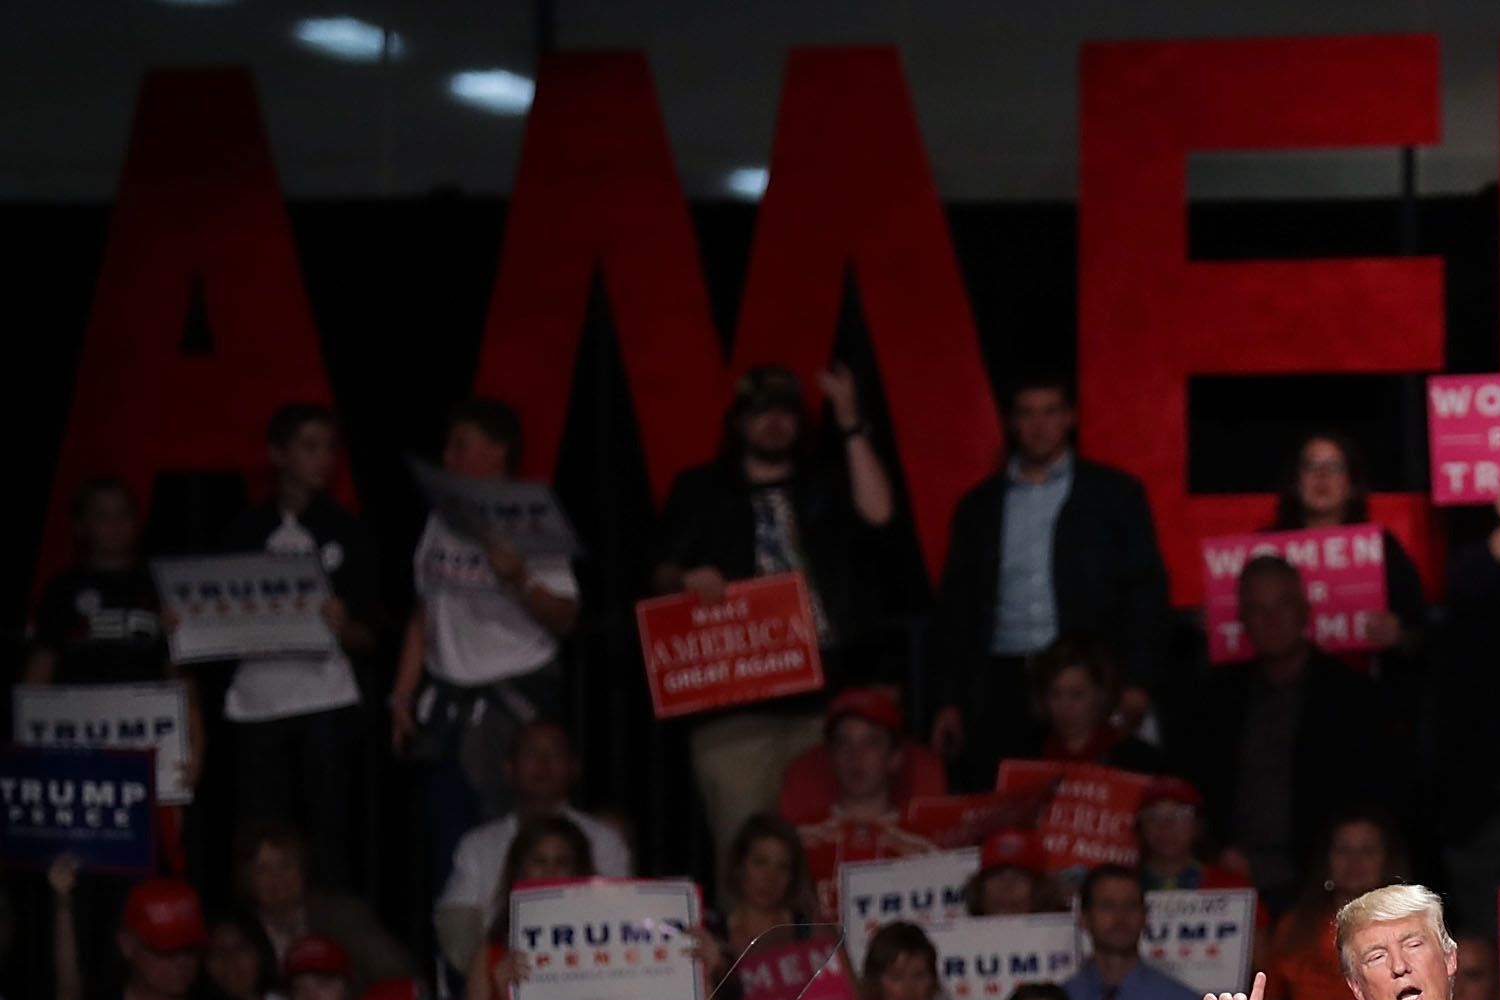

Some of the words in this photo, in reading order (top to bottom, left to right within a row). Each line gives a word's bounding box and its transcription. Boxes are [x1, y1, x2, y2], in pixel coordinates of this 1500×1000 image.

[1204, 532, 1384, 580] WMEN
[652, 615, 810, 667] AMERICA
[664, 665, 730, 693] GREAT
[734, 647, 804, 680] AGAIN
[28, 717, 174, 741] TRUMP
[0, 776, 148, 807] TRUMP
[856, 889, 969, 914] TRUM
[522, 917, 686, 948] TRUMP
[1143, 922, 1237, 942] UMP
[741, 945, 842, 994] MEN
[944, 953, 1074, 976] RUMP
